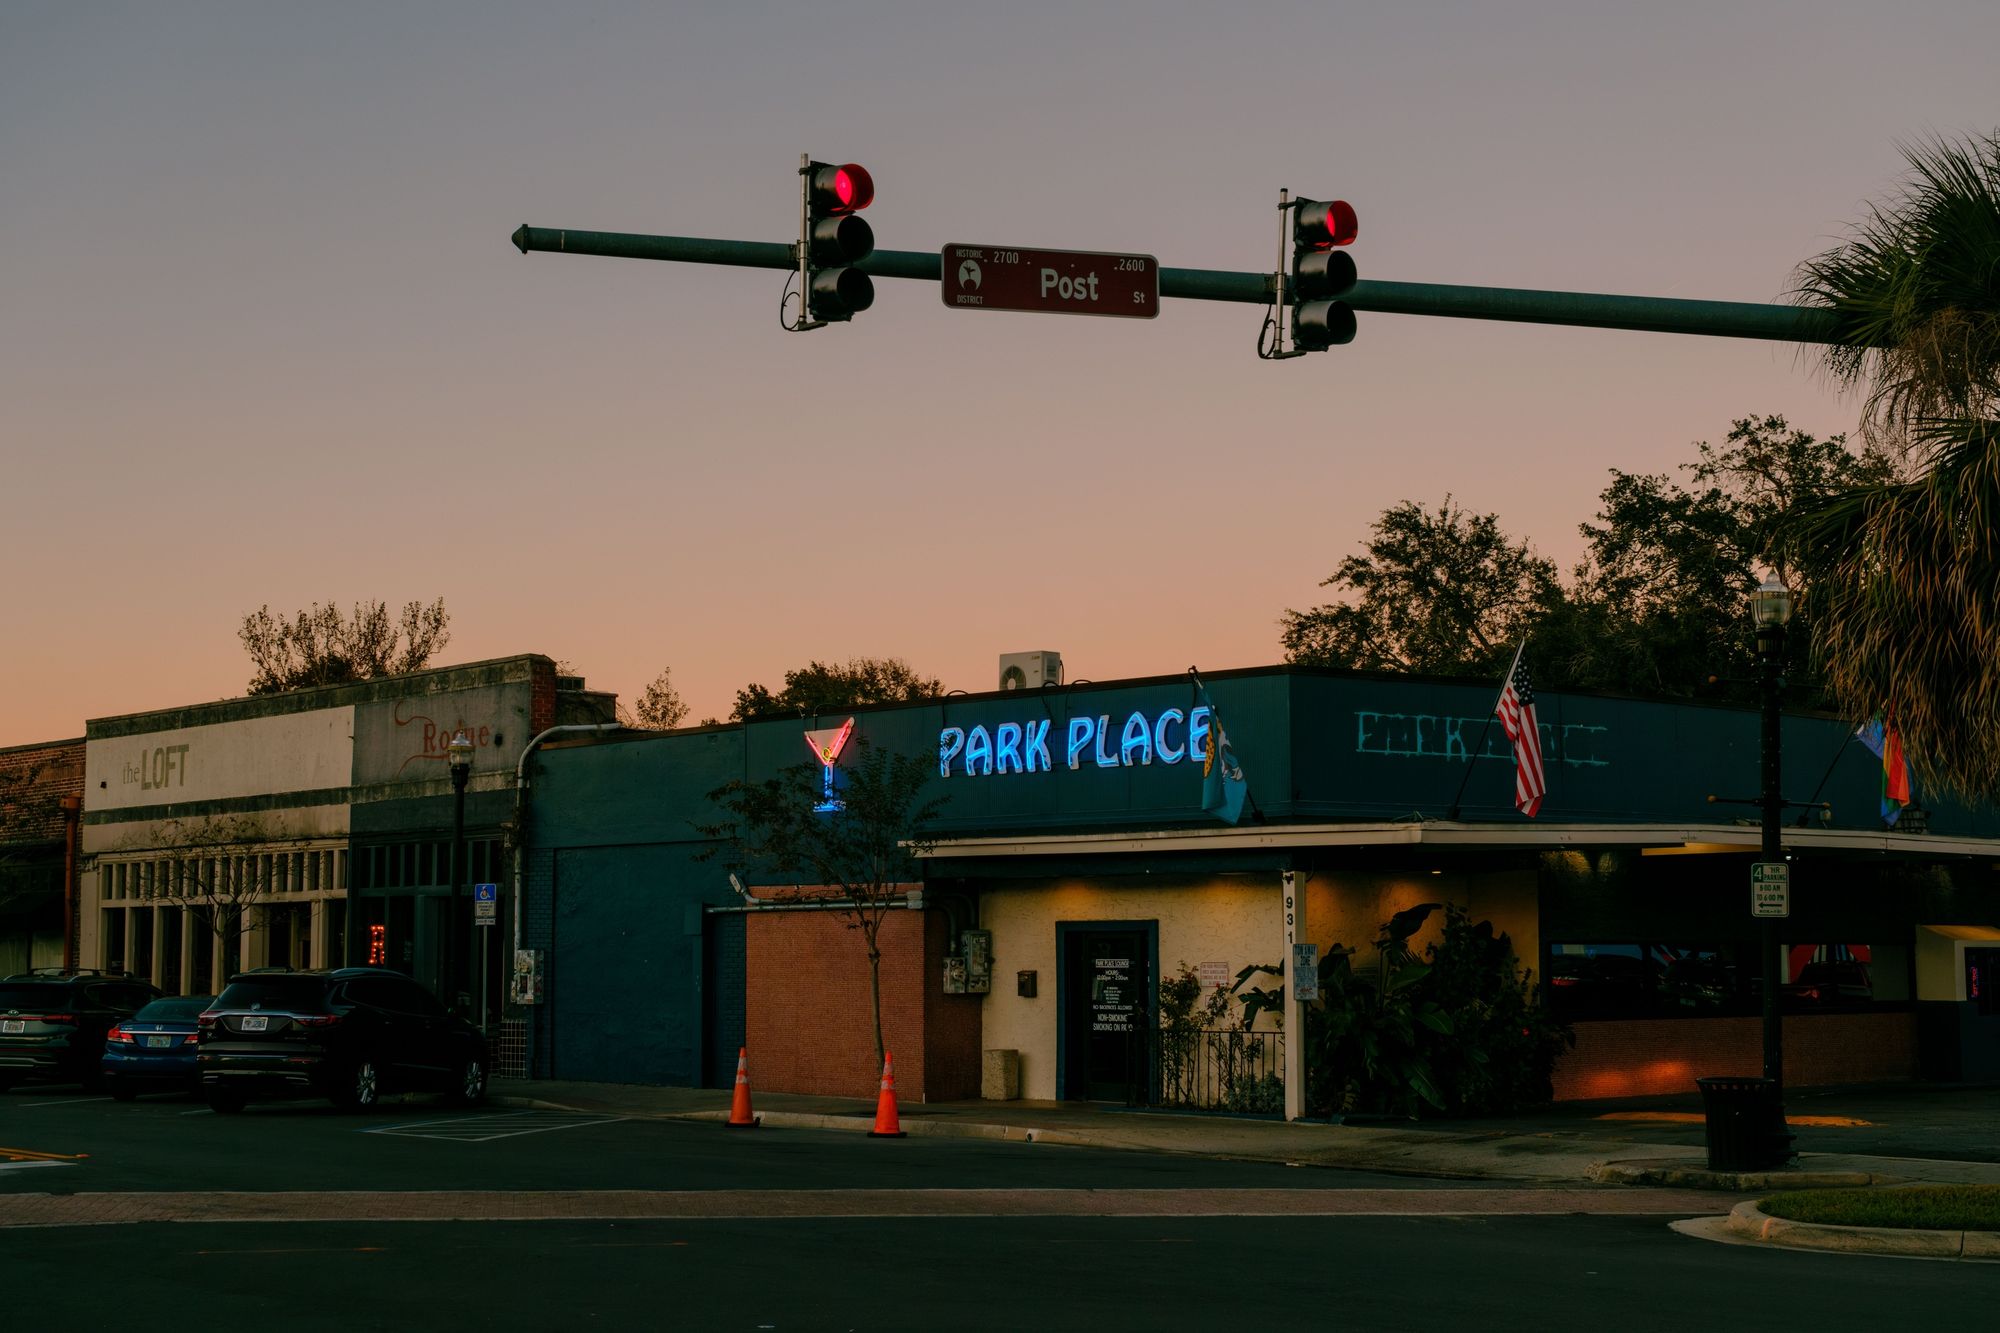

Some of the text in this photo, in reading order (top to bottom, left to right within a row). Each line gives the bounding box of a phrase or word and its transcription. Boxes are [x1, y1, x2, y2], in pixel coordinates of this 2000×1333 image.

[956, 249, 983, 259] HISTORIC
[993, 251, 1019, 264] 2700
[1119, 259, 1145, 272] 2600
[1040, 268, 1099, 301] Post
[956, 294, 984, 305] DISTRICT
[1133, 291, 1145, 304] St
[940, 705, 1210, 778] PARK PLACE
[122, 744, 189, 790] the LOFT
[1754, 867, 1762, 880] 4
[1093, 1022, 1113, 1031] SMOKING
[1113, 1023, 1120, 1031] ON
